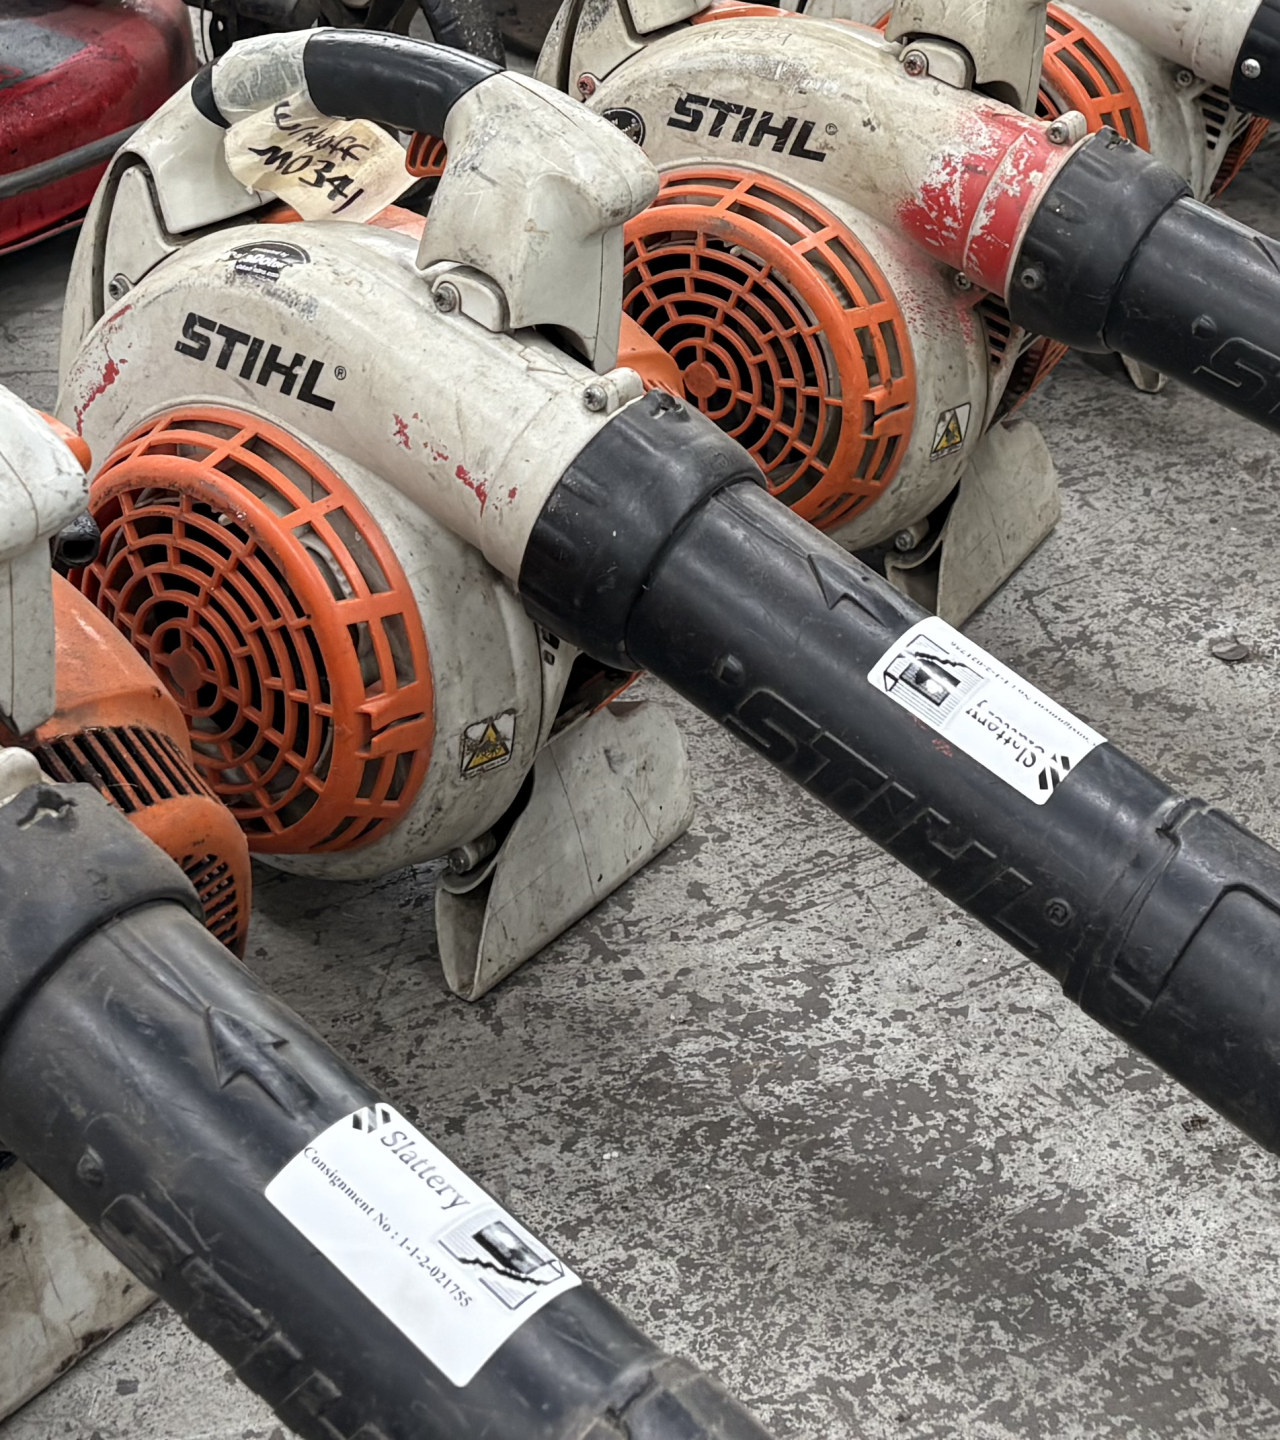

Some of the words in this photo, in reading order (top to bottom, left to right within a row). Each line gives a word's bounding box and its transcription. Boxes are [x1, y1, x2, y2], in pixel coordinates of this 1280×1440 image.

[666, 92, 827, 163] STIHL
[174, 311, 336, 412] STIHL
[723, 688, 1040, 954] STIHL
[380, 1129, 471, 1211] Slattery
[304, 1146, 376, 1216] Consignment
[373, 1212, 392, 1233] No
[399, 1237, 473, 1309] 1-1-2-021755
